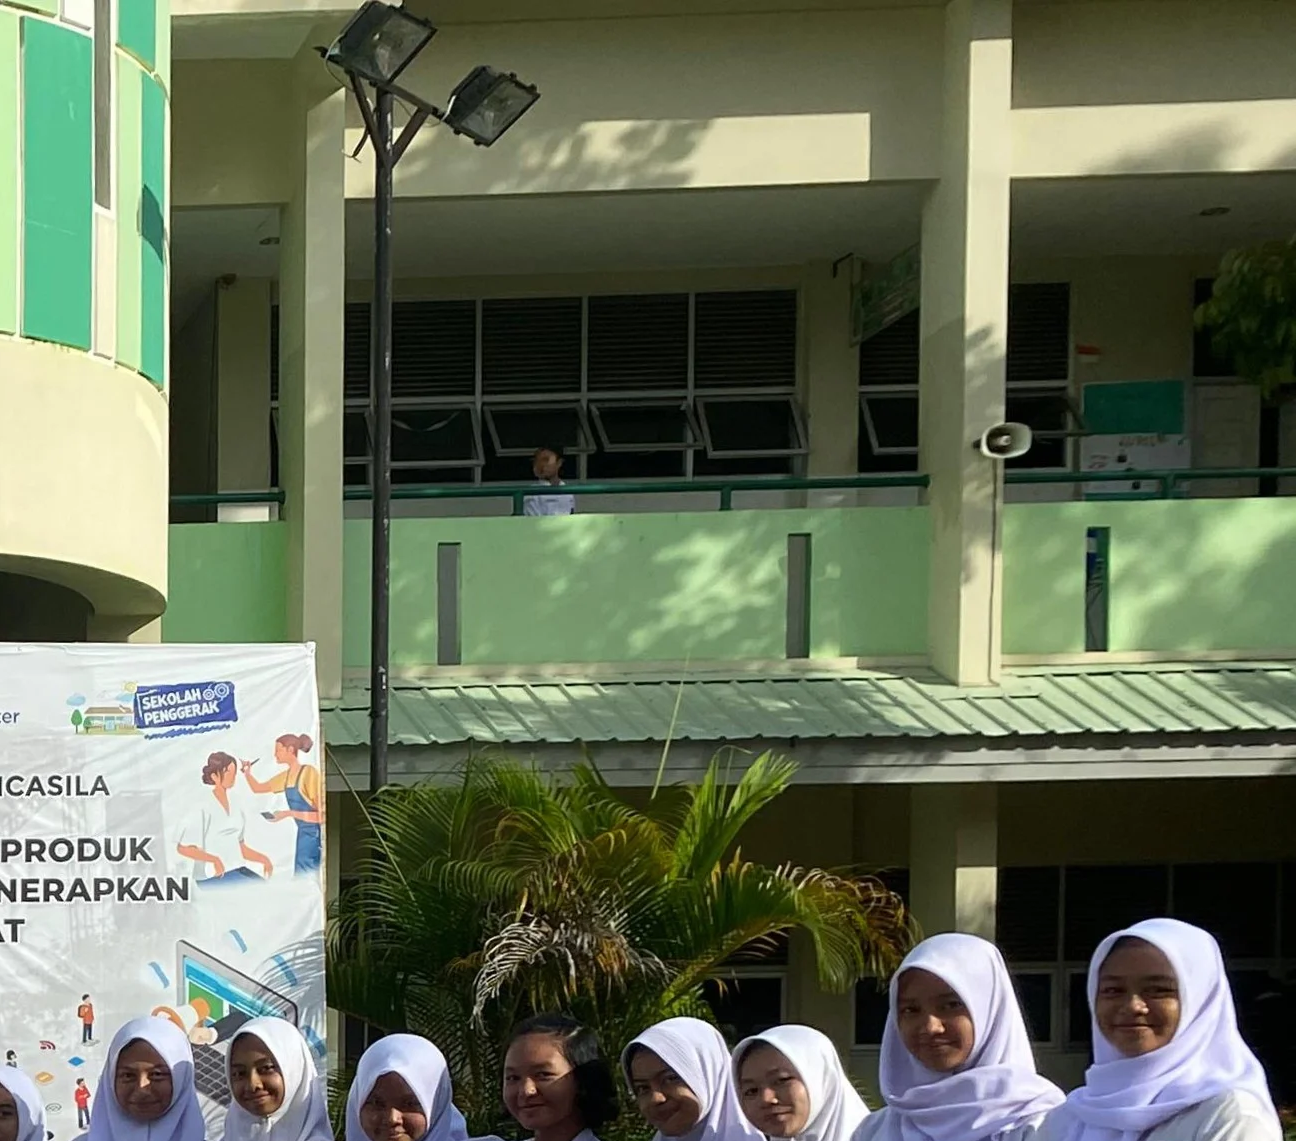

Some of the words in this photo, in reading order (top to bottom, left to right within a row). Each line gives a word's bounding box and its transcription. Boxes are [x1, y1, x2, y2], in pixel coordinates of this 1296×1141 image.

[141, 688, 201, 709] SEKOLAH
[143, 700, 220, 725] PENGGERAK
[1, 837, 152, 863] PRODUK
